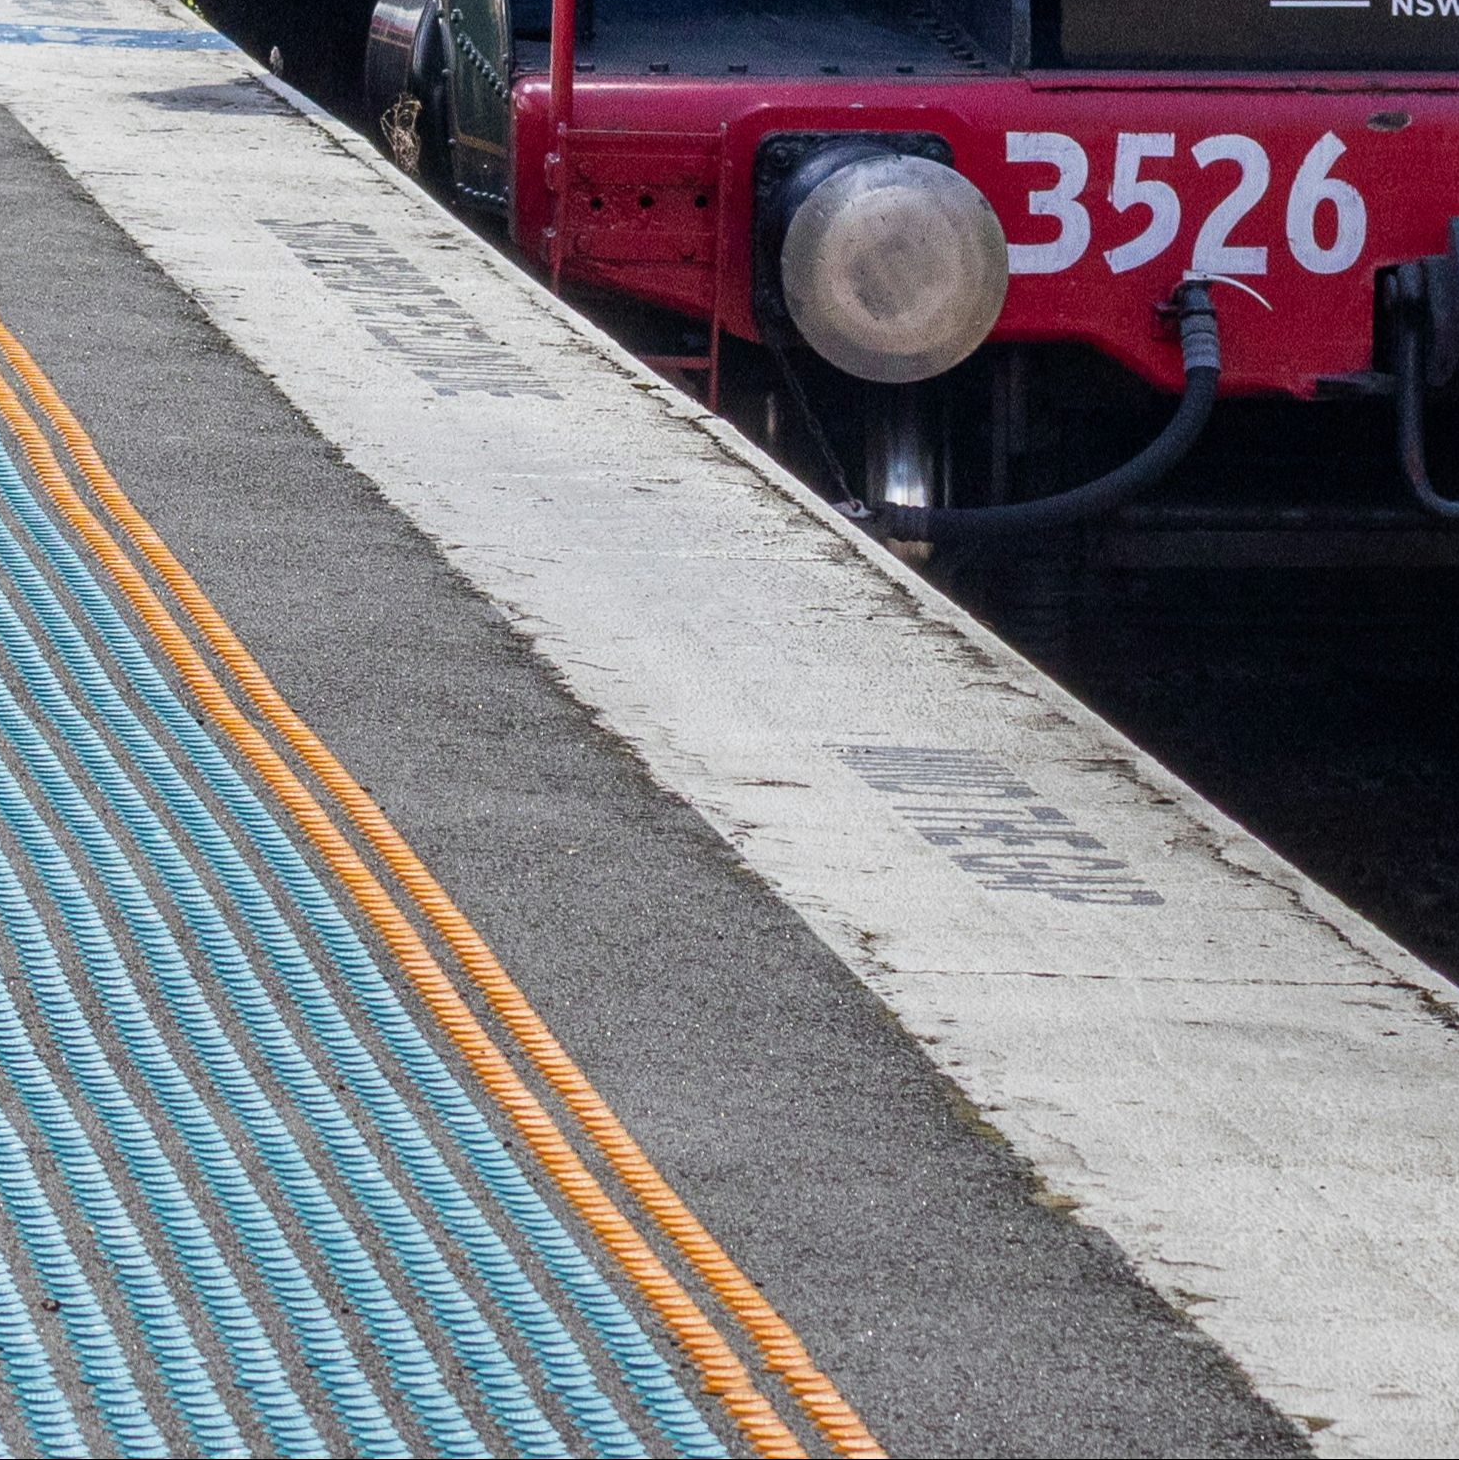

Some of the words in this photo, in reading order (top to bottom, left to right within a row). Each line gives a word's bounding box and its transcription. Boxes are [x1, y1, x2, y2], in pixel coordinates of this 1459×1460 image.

[1006, 131, 1367, 275] 3526
[822, 744, 1039, 798] MIND
[892, 805, 1108, 849] THE
[949, 853, 1166, 905] GAP
